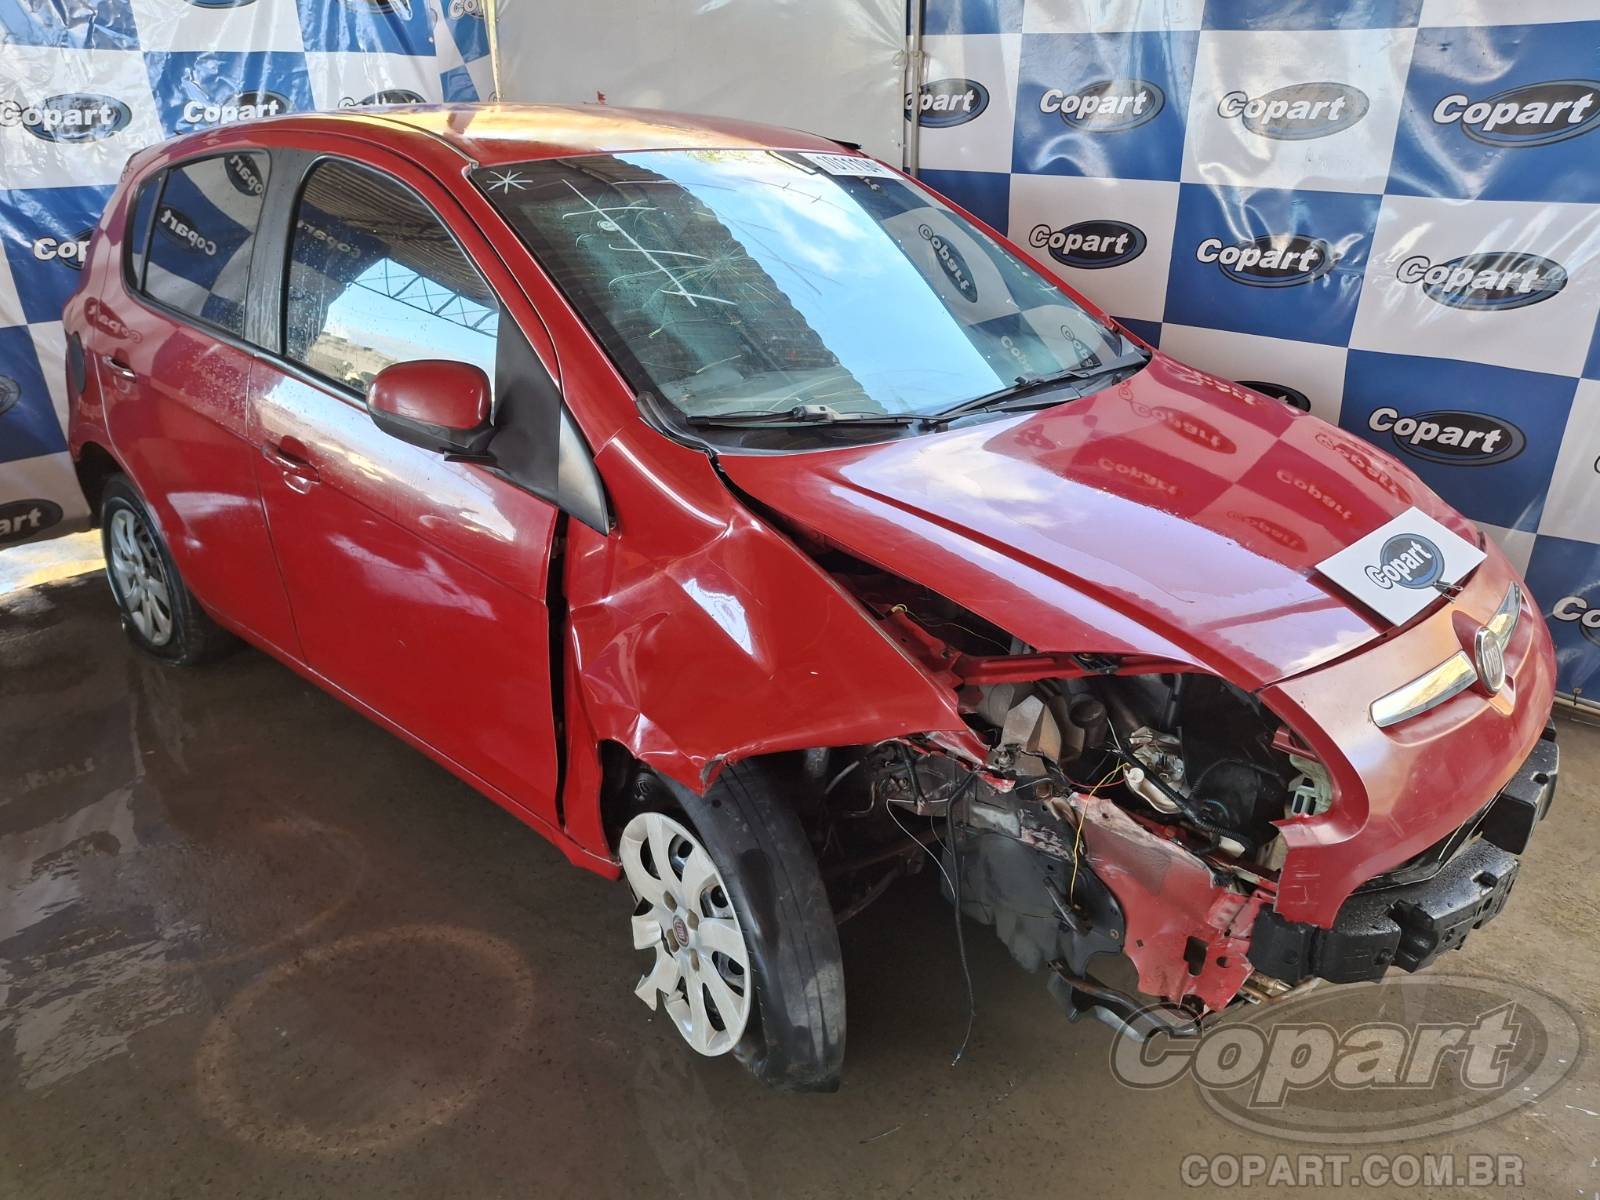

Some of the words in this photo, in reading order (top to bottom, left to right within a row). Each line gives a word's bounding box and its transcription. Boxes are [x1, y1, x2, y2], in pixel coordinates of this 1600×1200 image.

[0, 100, 113, 132] Copart
[183, 99, 280, 124] Copart
[904, 89, 975, 115] opart
[1040, 88, 1149, 119] Copart
[1218, 91, 1348, 125] Copart
[1434, 93, 1593, 131] Copart
[33, 238, 91, 262] Cop
[1029, 223, 1131, 255] Copart
[1195, 238, 1320, 272] Copart
[1397, 257, 1543, 294] Copart
[1369, 406, 1503, 454] Copart
[1364, 540, 1433, 590] Copart
